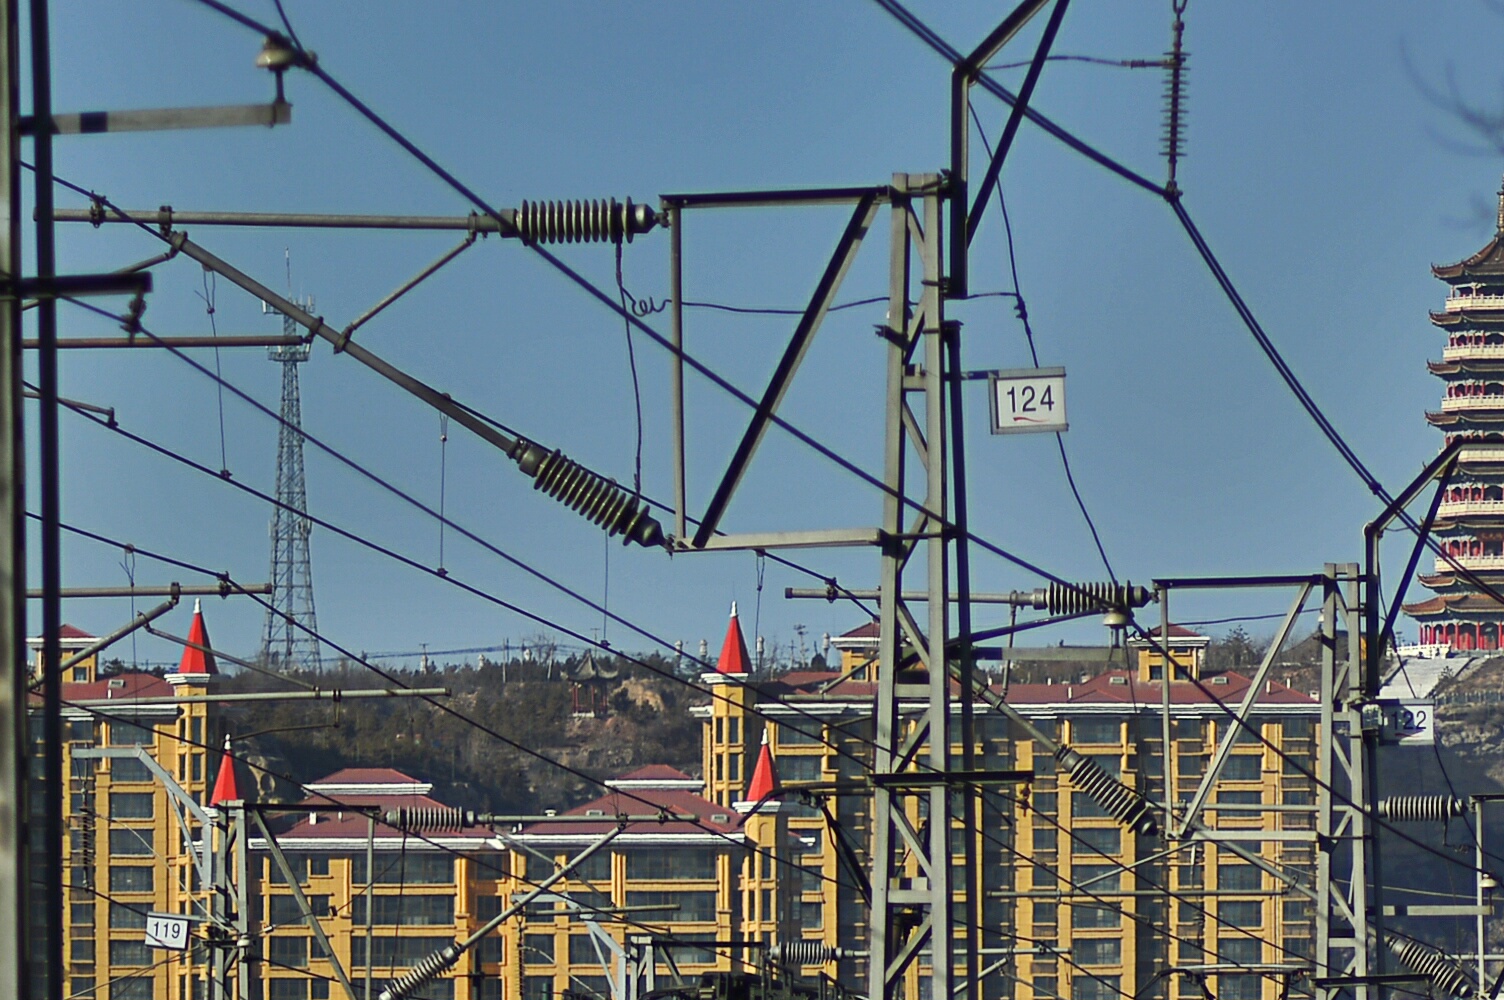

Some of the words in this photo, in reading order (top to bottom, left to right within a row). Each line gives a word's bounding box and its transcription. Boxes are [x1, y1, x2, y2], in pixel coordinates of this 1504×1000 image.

[1006, 384, 1055, 413] 124
[1391, 710, 1427, 730] 122
[153, 921, 181, 939] 119
